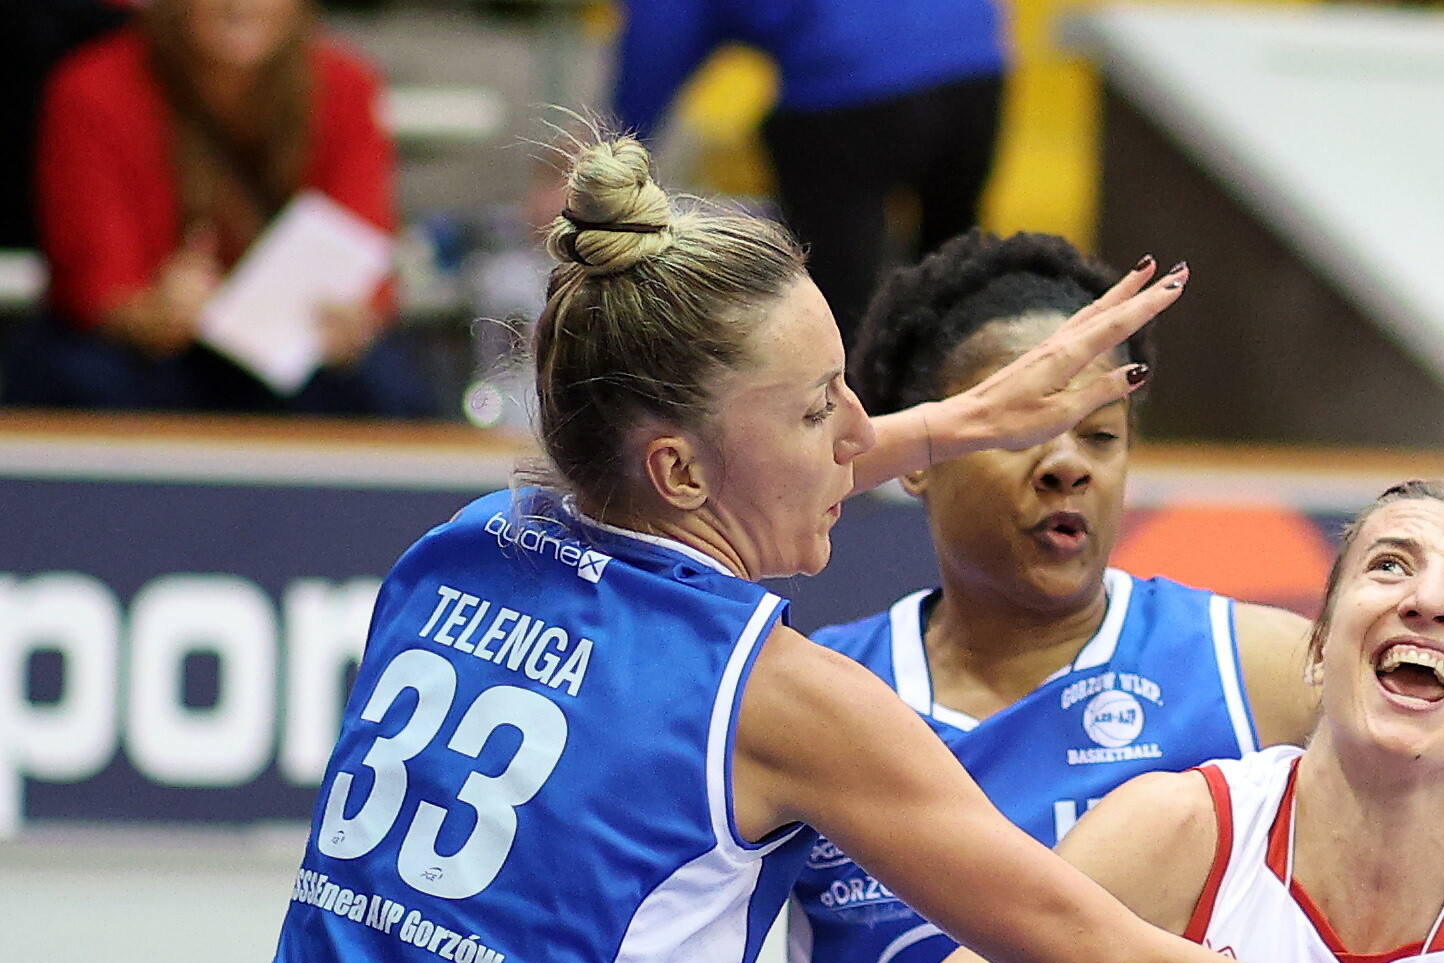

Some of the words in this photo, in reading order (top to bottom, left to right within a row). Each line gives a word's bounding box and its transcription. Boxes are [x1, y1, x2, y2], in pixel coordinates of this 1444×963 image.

[419, 586, 594, 696] TELENGA
[318, 648, 568, 899] 33
[366, 894, 405, 935] AJP
